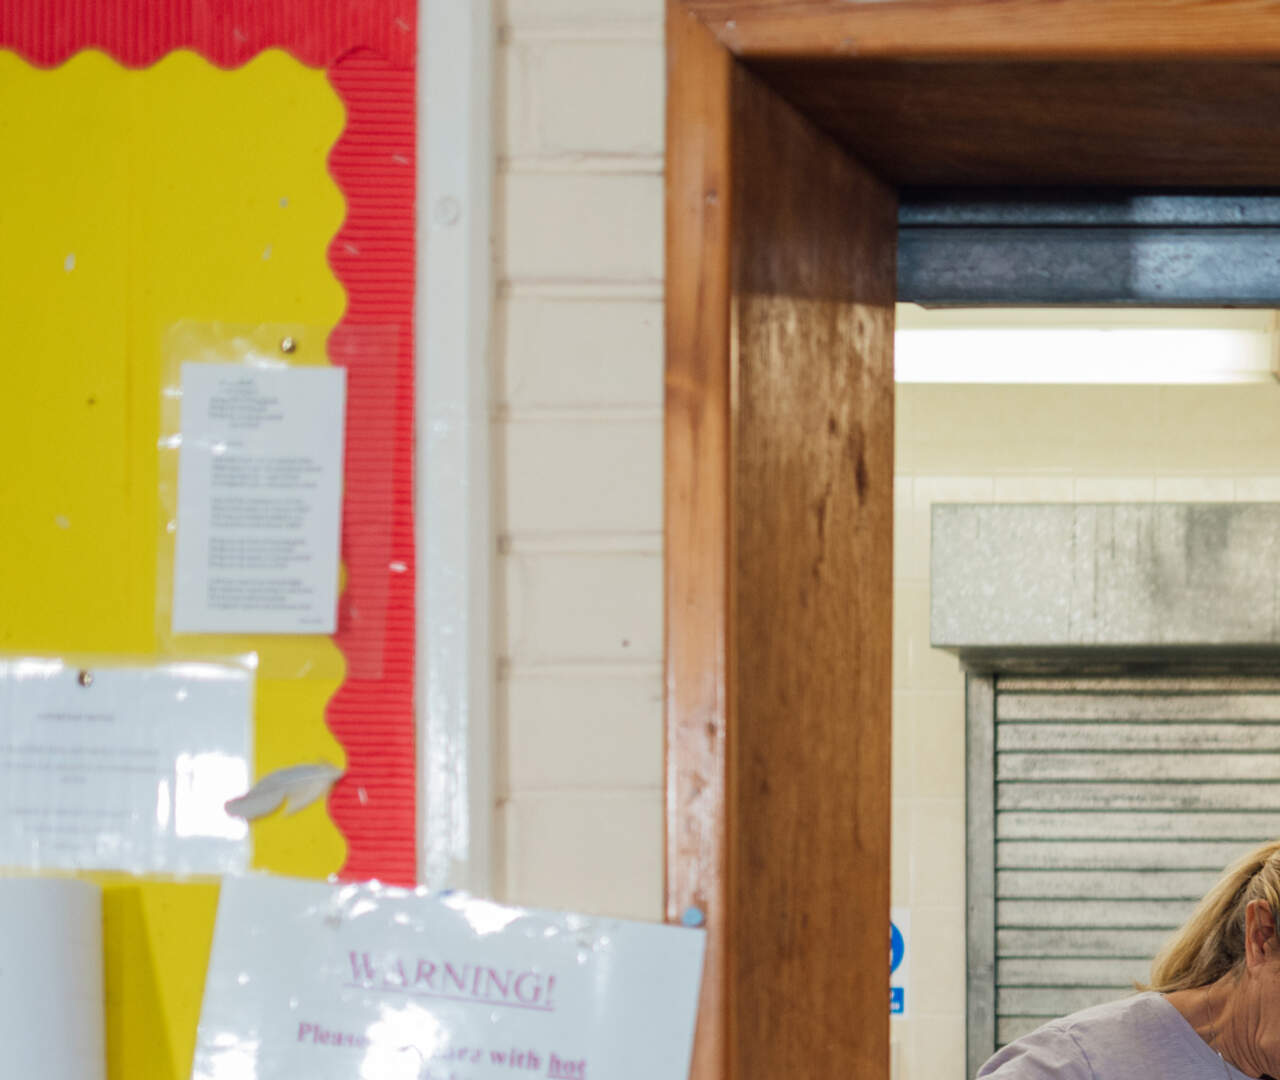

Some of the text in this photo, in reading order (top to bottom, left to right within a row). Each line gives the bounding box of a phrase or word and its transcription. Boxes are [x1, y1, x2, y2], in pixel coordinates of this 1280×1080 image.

[346, 949, 556, 1009] WARNING!
[489, 1047, 541, 1071] with
[547, 1053, 587, 1080] hot
